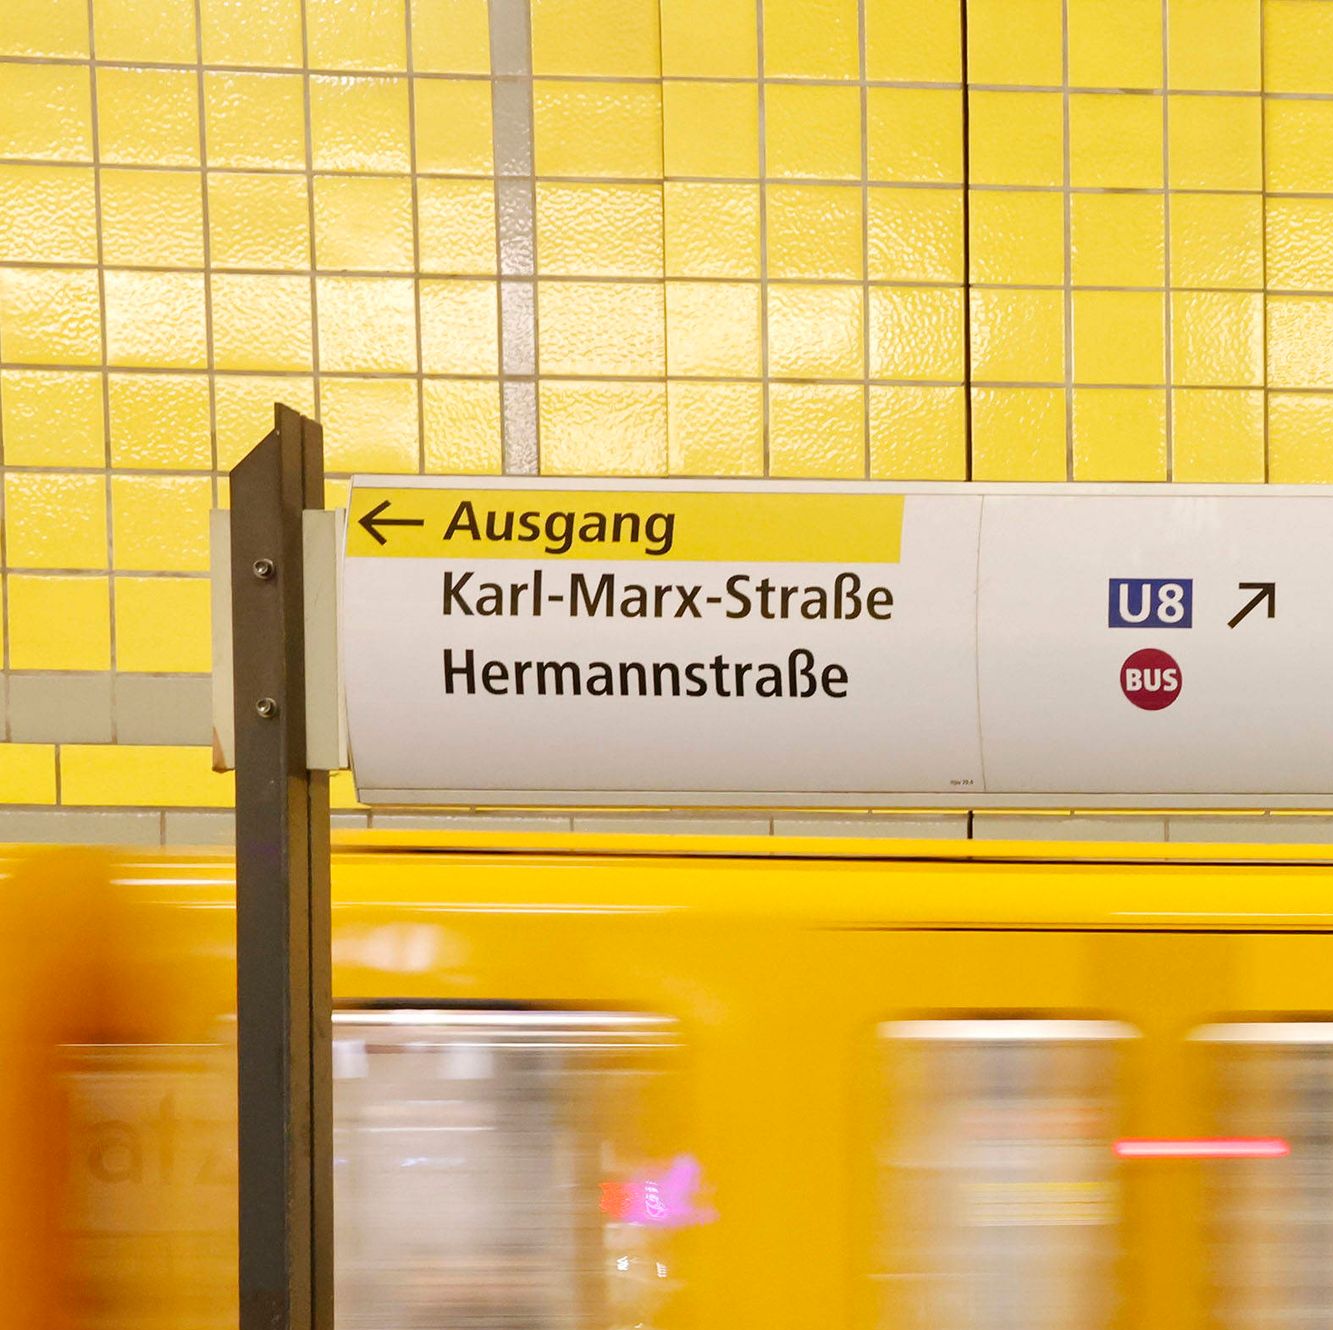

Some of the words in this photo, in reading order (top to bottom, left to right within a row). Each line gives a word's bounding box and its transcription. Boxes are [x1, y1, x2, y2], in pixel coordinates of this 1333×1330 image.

[443, 501, 676, 554] Ausgang
[442, 570, 894, 620] Karl-Marx-Straße
[1117, 583, 1185, 624] U8
[443, 648, 849, 699] Hermannstraße
[1125, 667, 1178, 693] BUS
